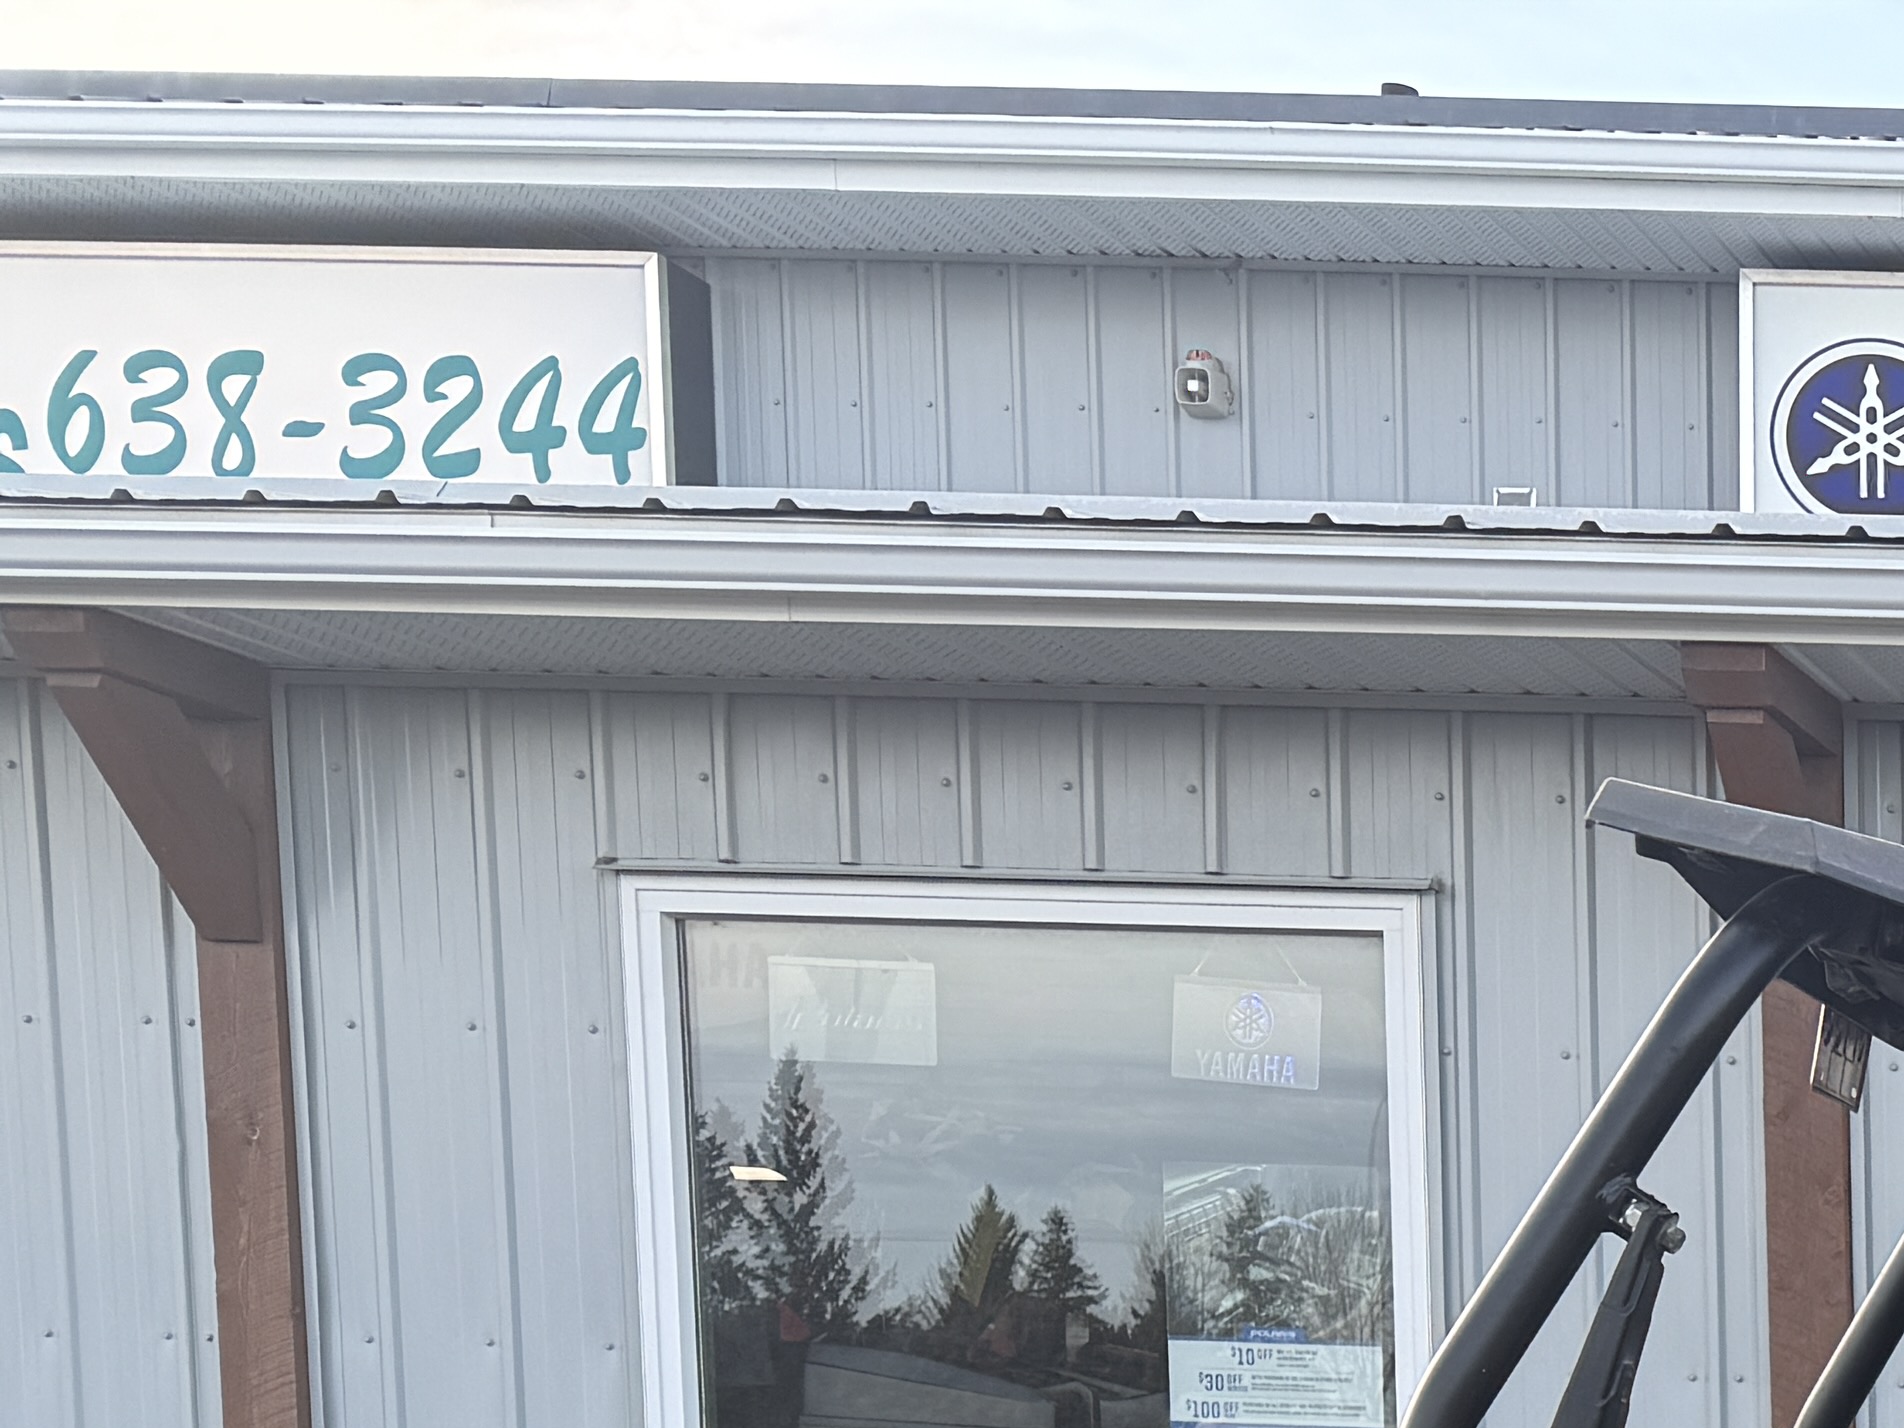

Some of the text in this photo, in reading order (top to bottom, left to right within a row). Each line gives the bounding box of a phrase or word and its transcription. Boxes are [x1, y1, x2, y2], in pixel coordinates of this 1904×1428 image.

[47, 349, 647, 484] 638-3244
[1195, 1048, 1295, 1085] YAMAHA
[1231, 1346, 1255, 1365] $10
[1199, 1371, 1224, 1391] $30
[1186, 1398, 1221, 1418] $100
